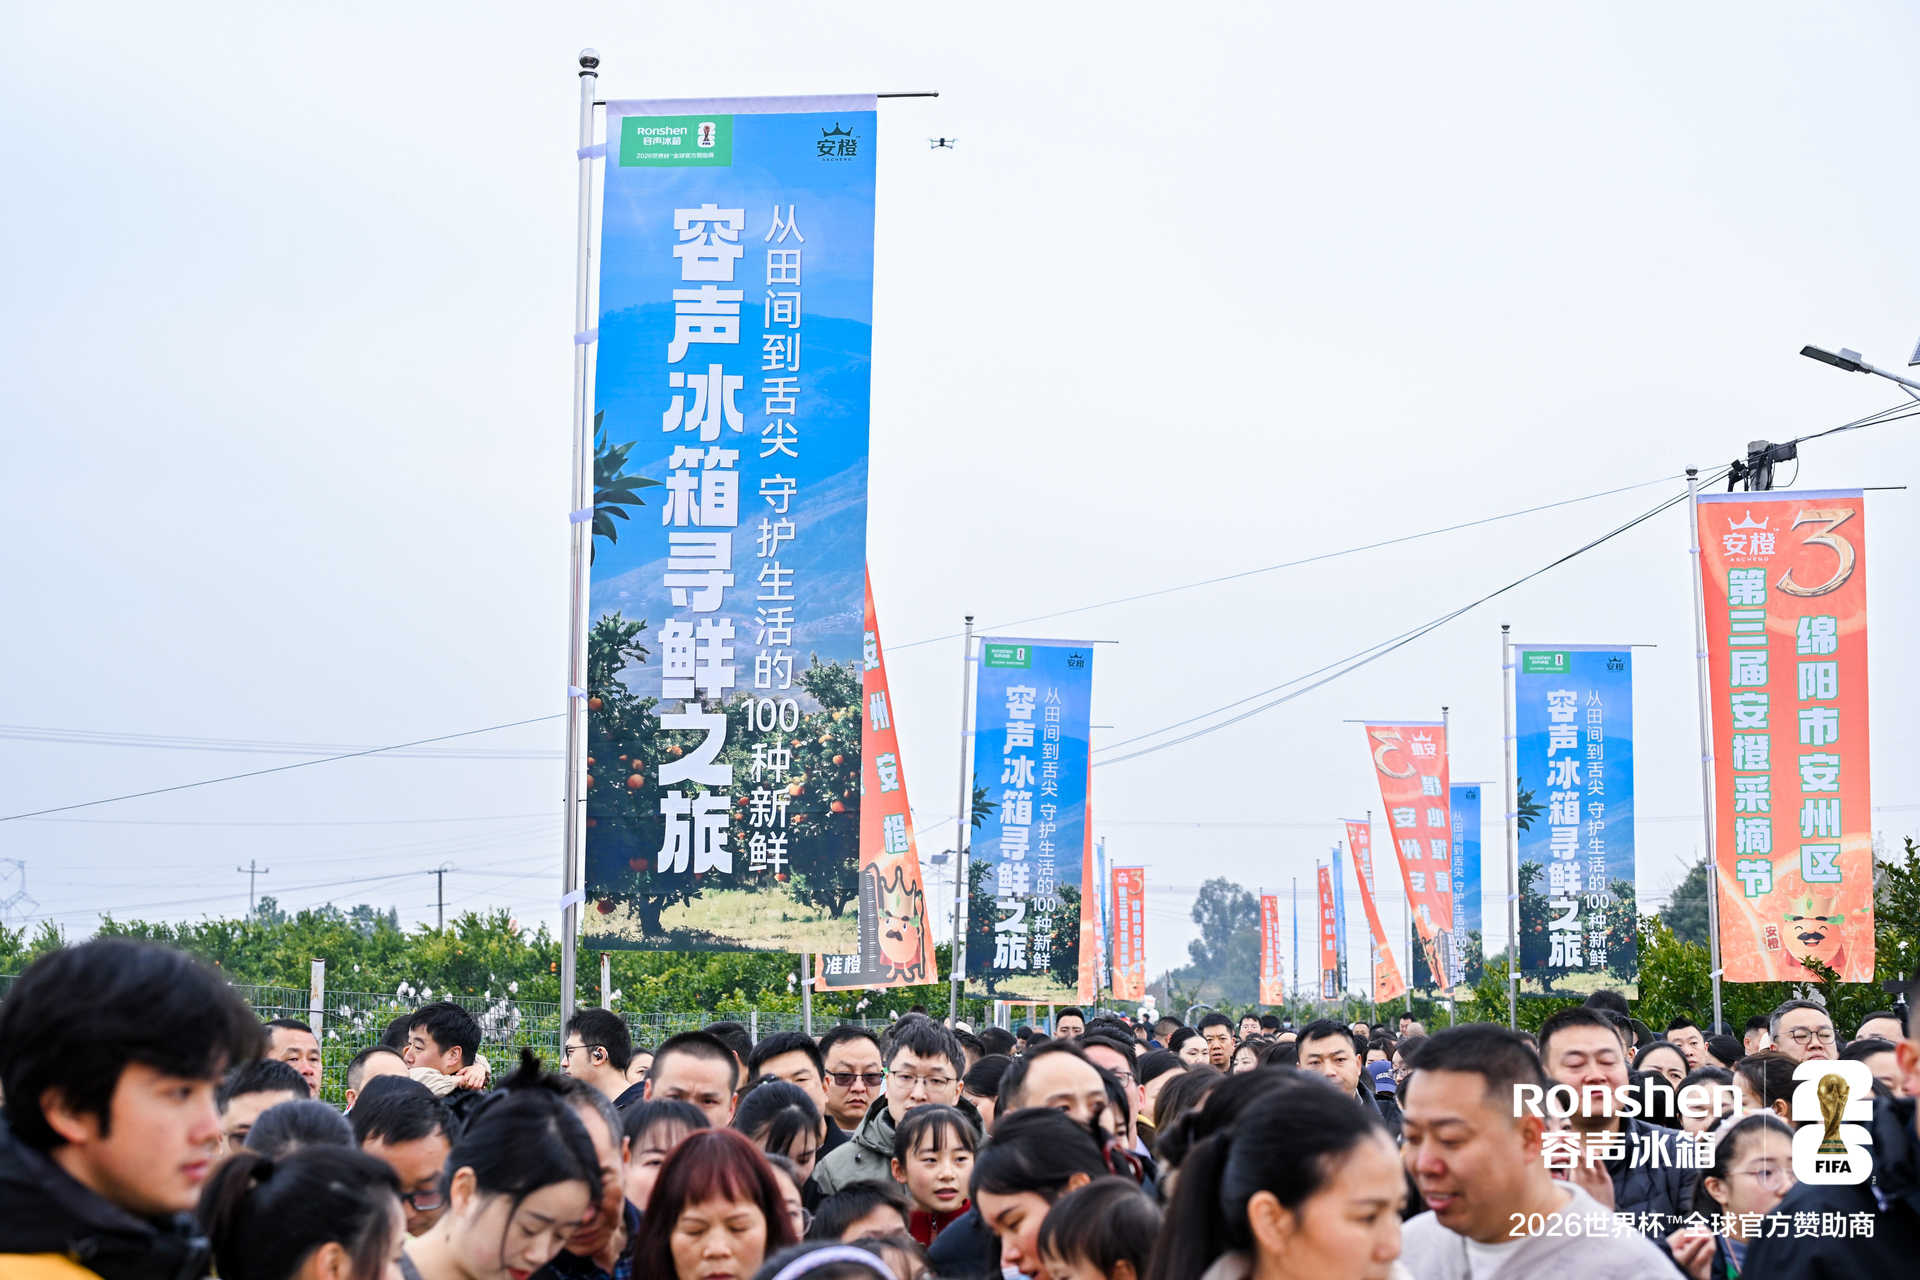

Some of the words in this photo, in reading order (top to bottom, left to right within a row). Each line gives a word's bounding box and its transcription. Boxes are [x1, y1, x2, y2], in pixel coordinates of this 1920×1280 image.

[637, 126, 688, 135] Ronshen
[816, 139, 857, 157] 安橙
[759, 204, 805, 459] 从田间到舌尖
[657, 203, 745, 874] 容声冰箱寻鲜之旅
[1722, 532, 1776, 556] 安橙
[1775, 508, 1856, 598] 3
[1041, 687, 1062, 798] 从田间到舌尖
[1585, 690, 1604, 796] 从田间到舌尖
[1727, 567, 1773, 897] 第三届安橙采摘节
[1796, 614, 1842, 883] 绵阳市安州区
[993, 684, 1037, 970] 容声冰箱寻鲜之旅
[1546, 688, 1583, 969] 容声冰箱寻鲜之旅
